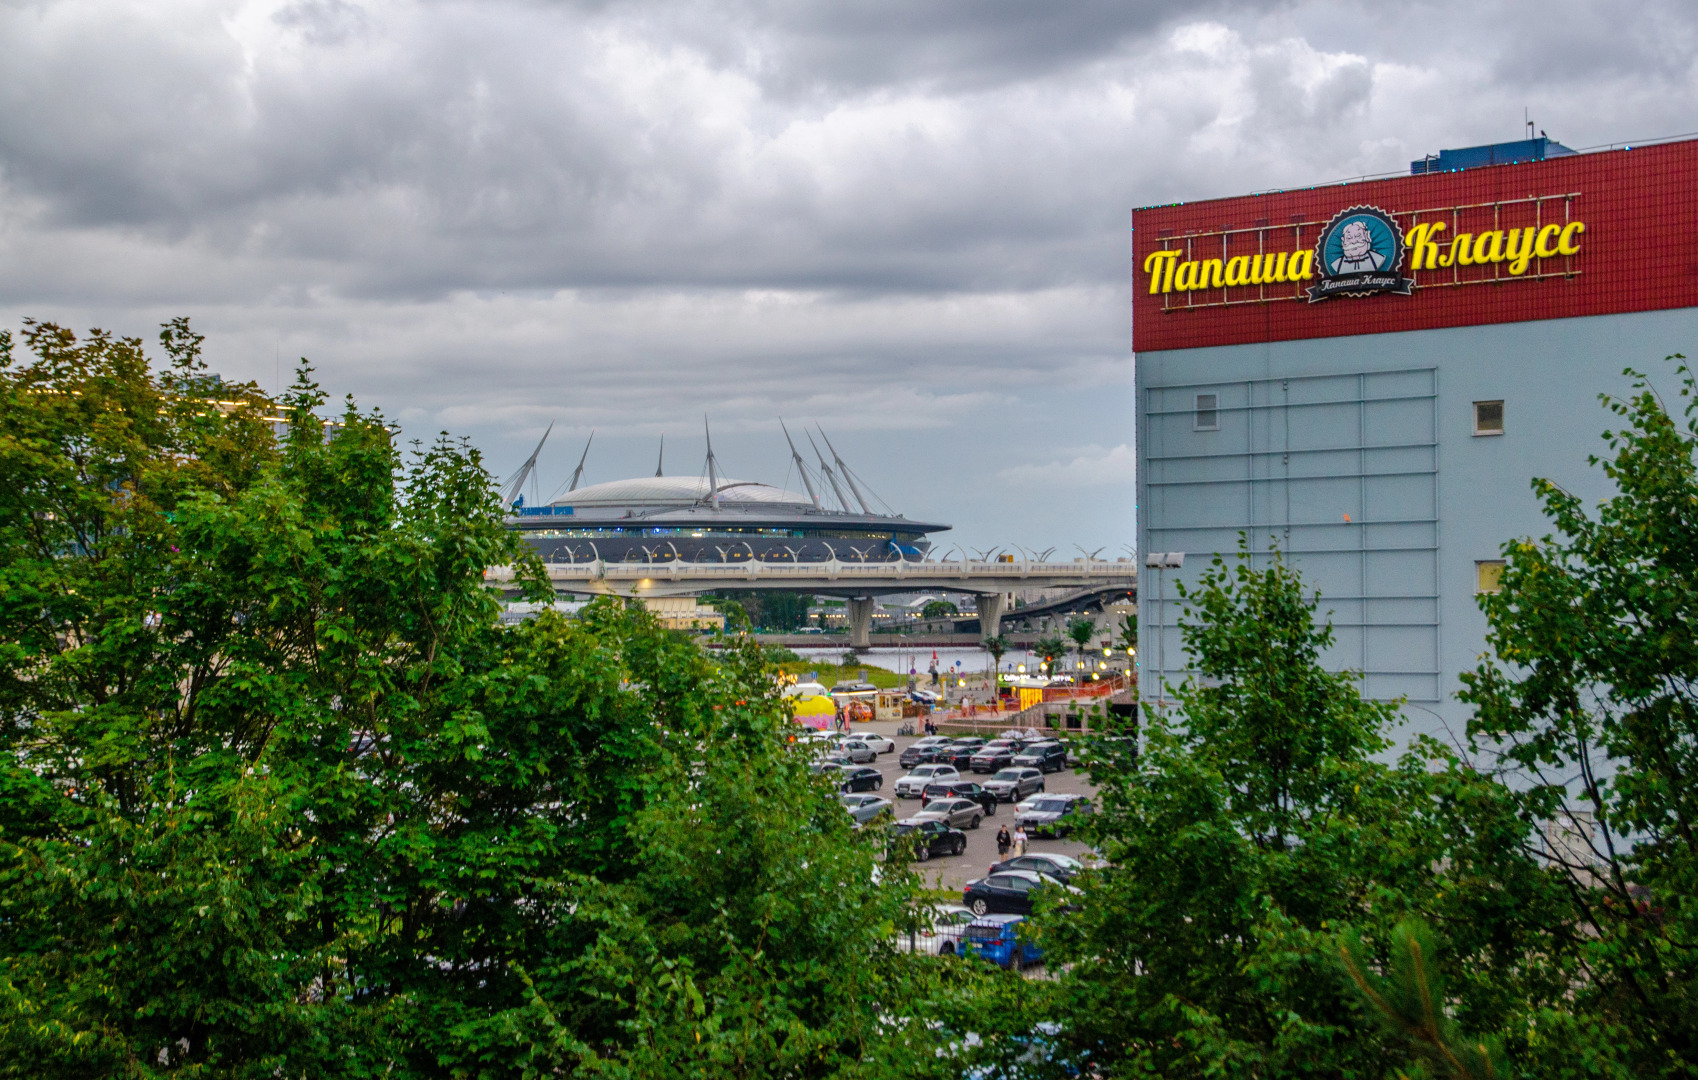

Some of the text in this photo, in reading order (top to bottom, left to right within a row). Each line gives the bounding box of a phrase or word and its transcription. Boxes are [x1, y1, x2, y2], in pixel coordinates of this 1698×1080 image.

[1144, 221, 1585, 295] Папаша Клаусс
[1321, 274, 1396, 291] Папаша Клаусс
